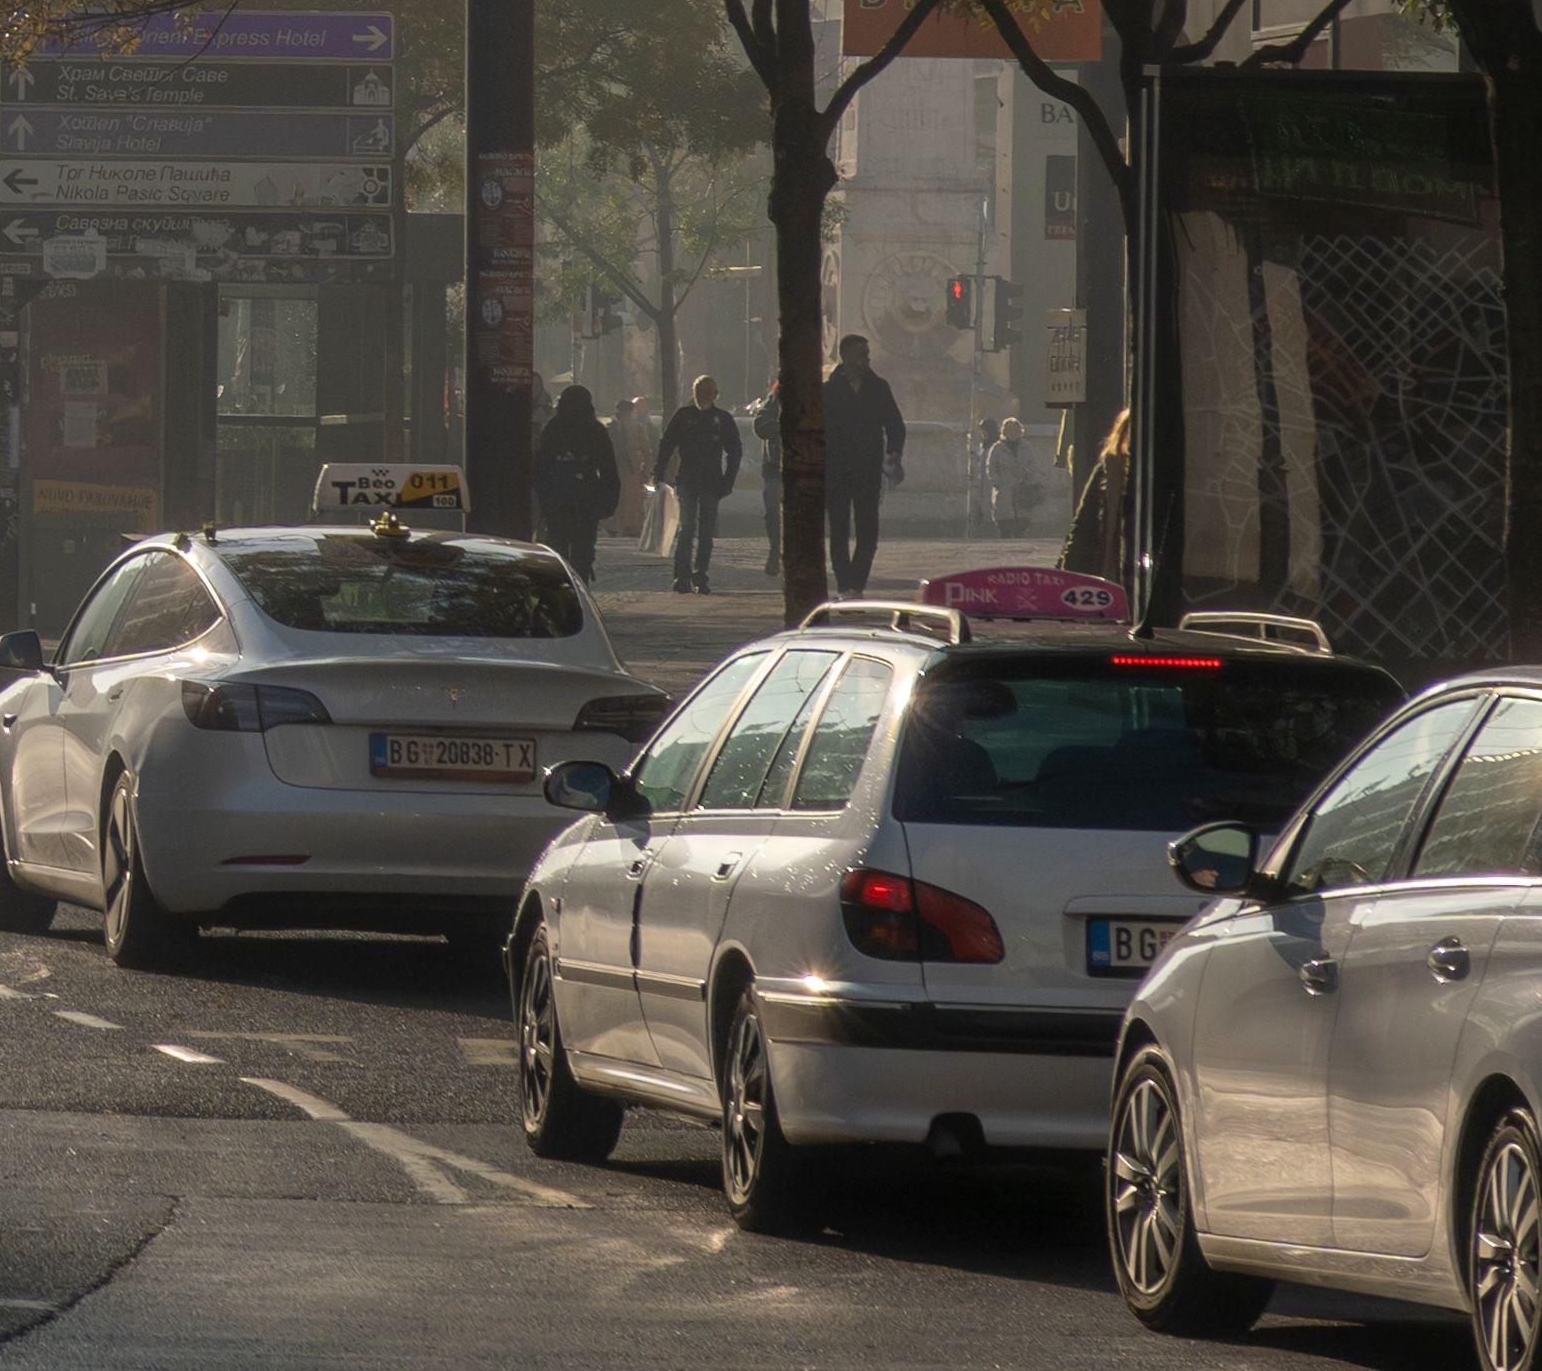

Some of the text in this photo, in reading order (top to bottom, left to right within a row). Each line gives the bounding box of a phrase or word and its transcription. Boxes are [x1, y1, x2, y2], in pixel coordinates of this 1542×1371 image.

[275, 29, 329, 47] Hotel
[57, 65, 105, 83] Храм
[181, 65, 230, 83] Саве
[56, 84, 79, 101] St.
[55, 134, 164, 154] Slavija Hotel
[56, 163, 232, 182] Трг Николе Пашића
[55, 184, 110, 201] Nikola
[1054, 191, 1077, 212] U
[55, 214, 128, 232] Савезна
[358, 473, 449, 490] Beo 011
[331, 481, 403, 506] TAXI
[987, 571, 1065, 587] RADIO TAXI
[1062, 590, 1112, 606] 429
[390, 740, 419, 764] BG
[1116, 927, 1157, 961] BG
